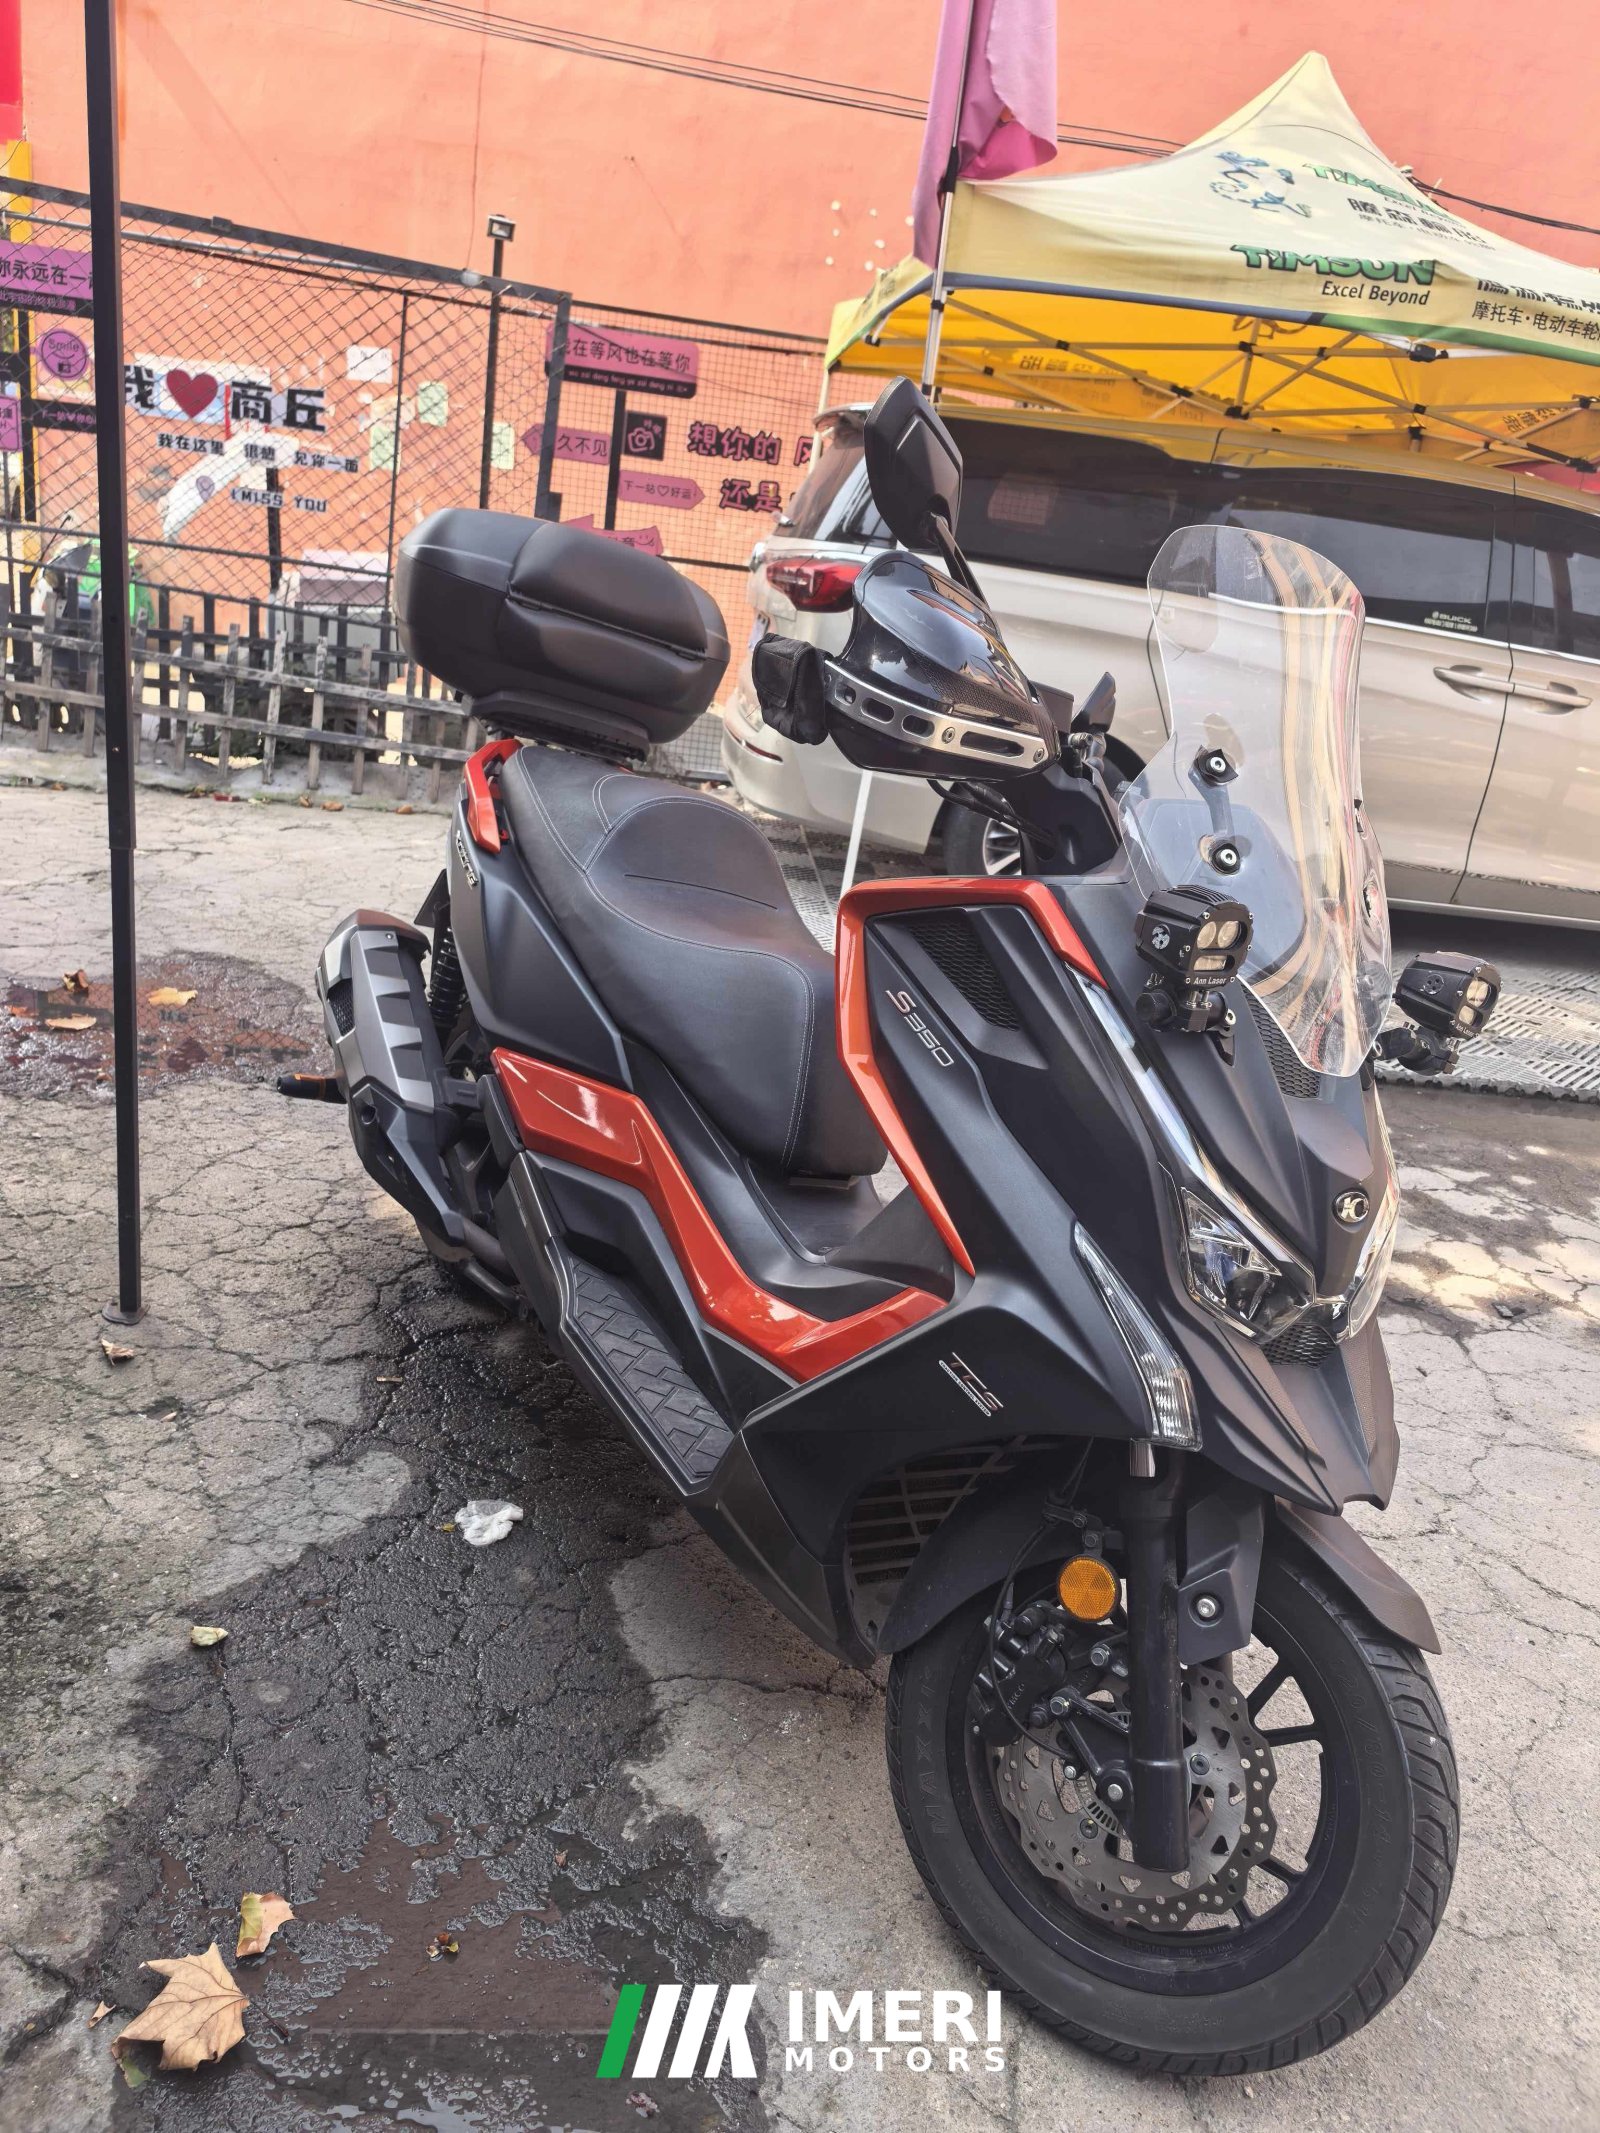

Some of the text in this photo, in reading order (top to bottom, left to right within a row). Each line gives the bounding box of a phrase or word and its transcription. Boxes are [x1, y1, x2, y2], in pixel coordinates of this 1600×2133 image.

[1230, 244, 1435, 286] TIMSUN
[1321, 280, 1431, 307] Excel Beyond
[1472, 300, 1600, 341] 摩托车·电动车轮
[230, 381, 327, 432] 商丘
[157, 433, 225, 456] 我在这里
[687, 421, 781, 465] 想你的
[294, 496, 328, 512] YOU
[719, 478, 782, 512] 还是
[885, 989, 955, 1068] S350
